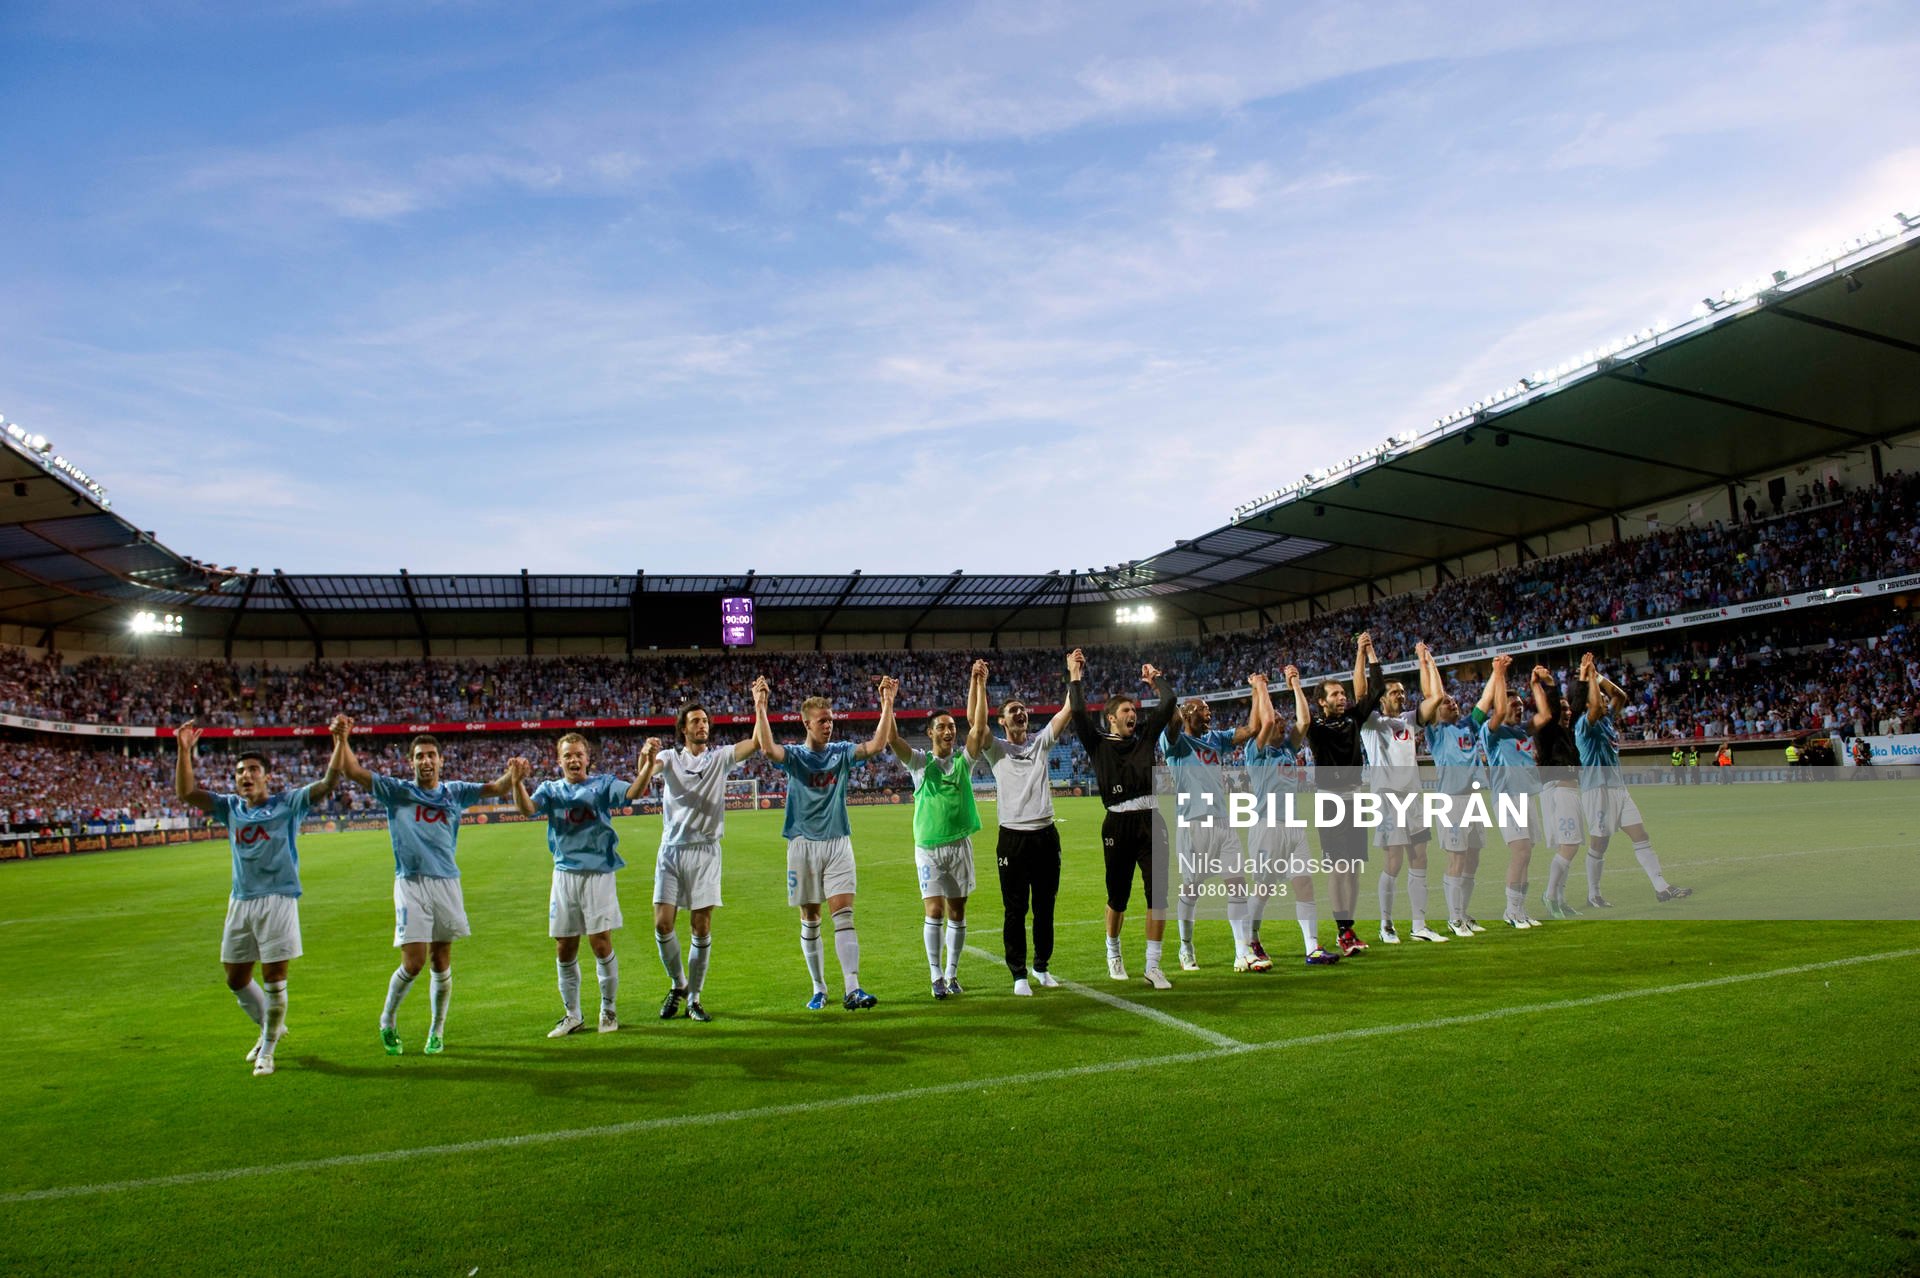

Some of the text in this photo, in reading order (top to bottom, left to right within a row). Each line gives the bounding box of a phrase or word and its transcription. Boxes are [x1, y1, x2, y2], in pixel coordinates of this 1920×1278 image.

[725, 615, 750, 624] 90:00
[1847, 744, 1888, 758] Sska
[235, 824, 271, 845] ICA
[998, 856, 1009, 867] 24
